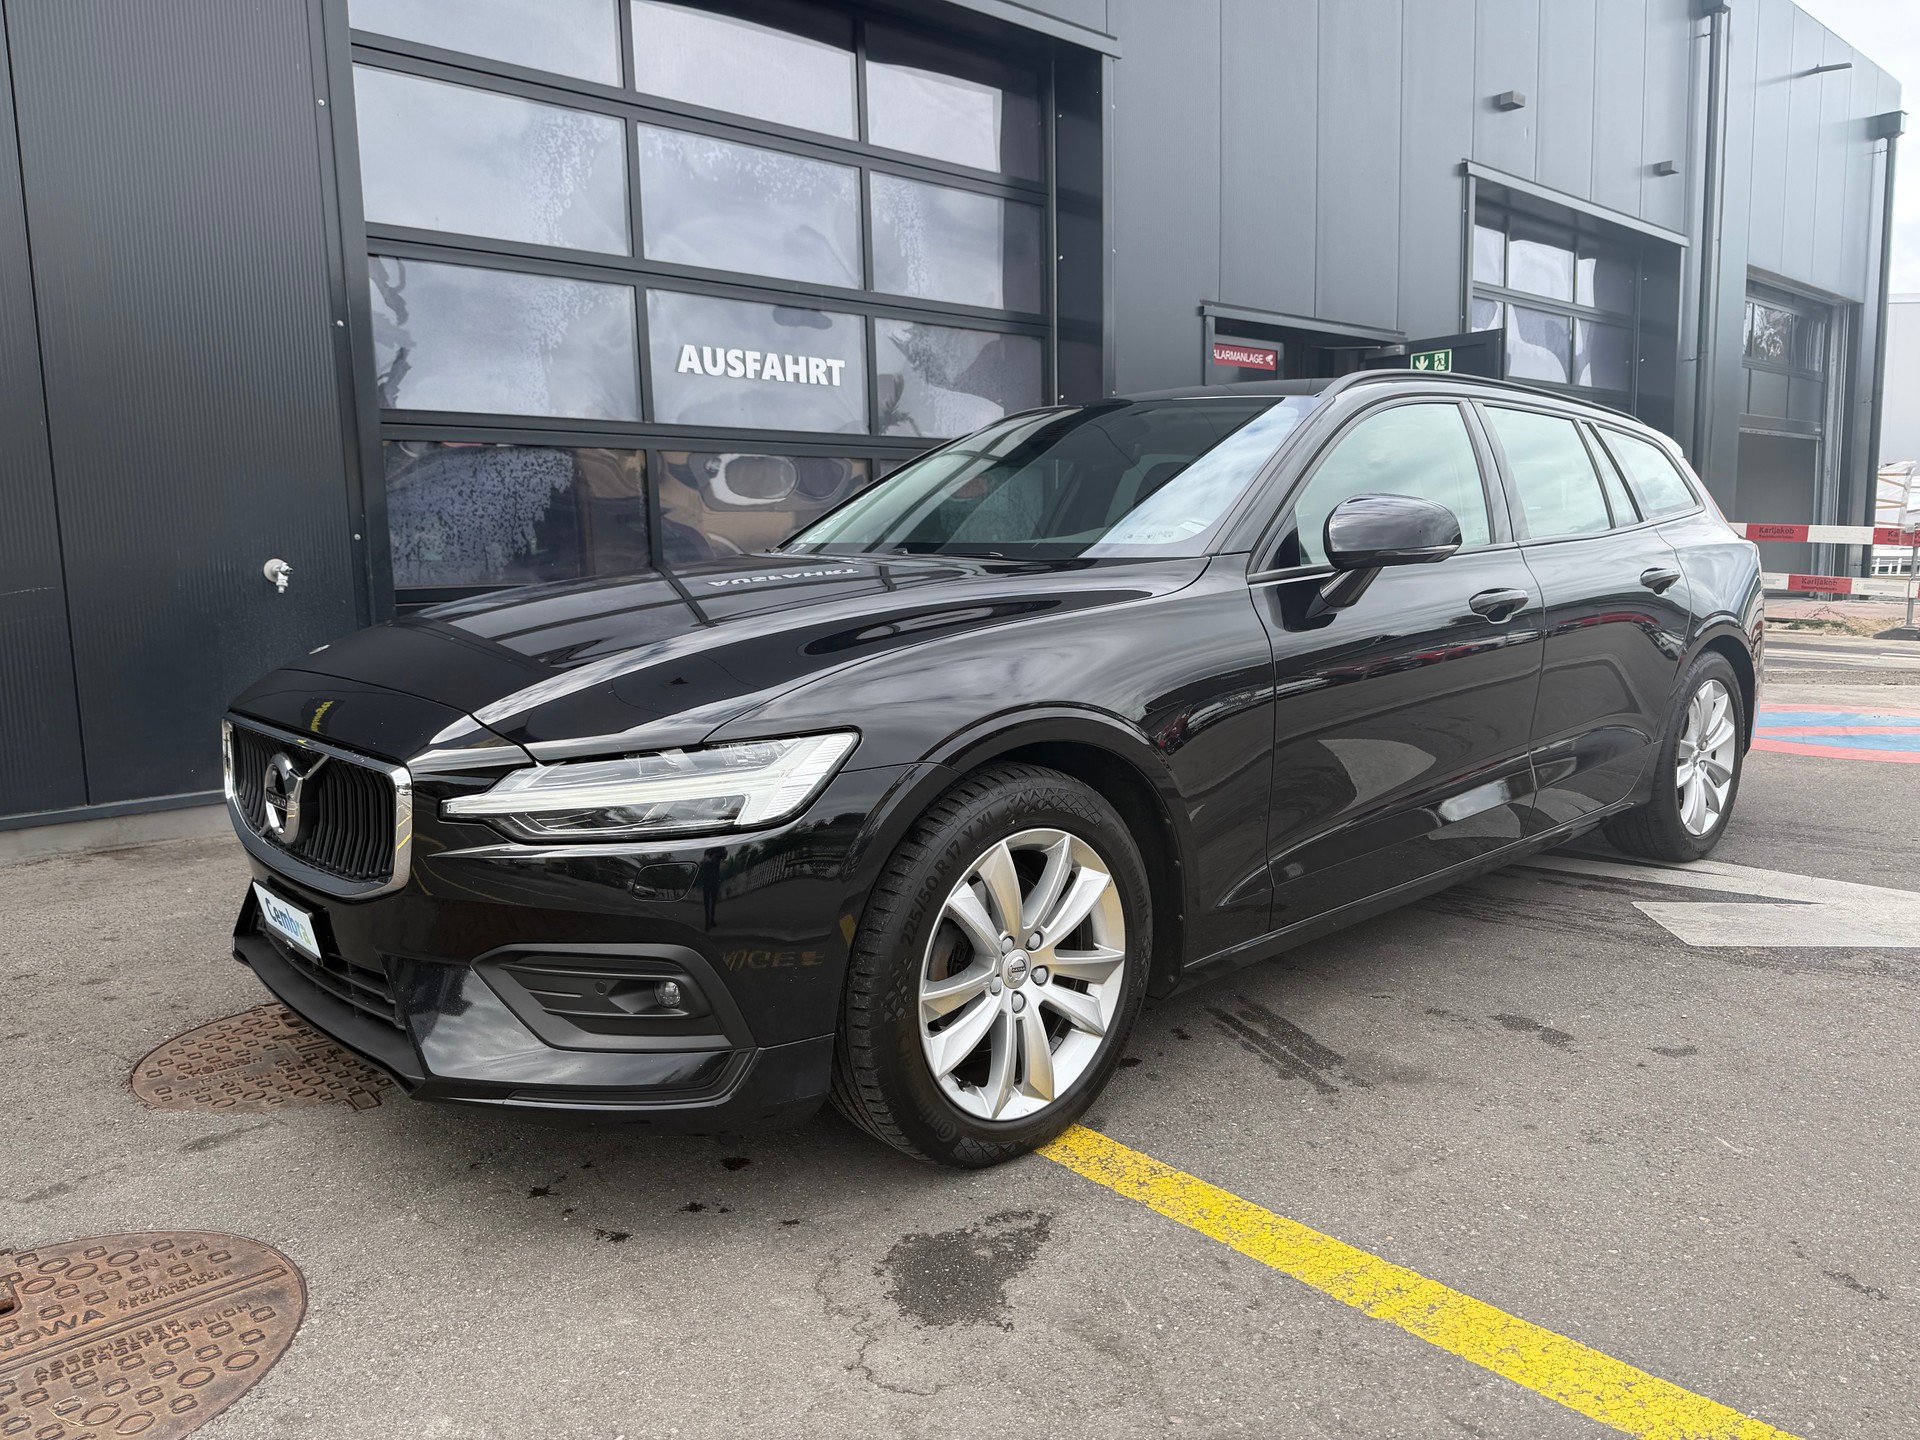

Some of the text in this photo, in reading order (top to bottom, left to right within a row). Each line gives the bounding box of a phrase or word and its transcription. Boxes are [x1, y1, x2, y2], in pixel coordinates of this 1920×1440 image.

[677, 344, 845, 386] AUSFAHRT
[900, 876, 940, 947] 225/50
[935, 858, 950, 876] R
[946, 840, 962, 861] 17
[265, 897, 312, 946] Cembra
[130, 1258, 160, 1275] EN
